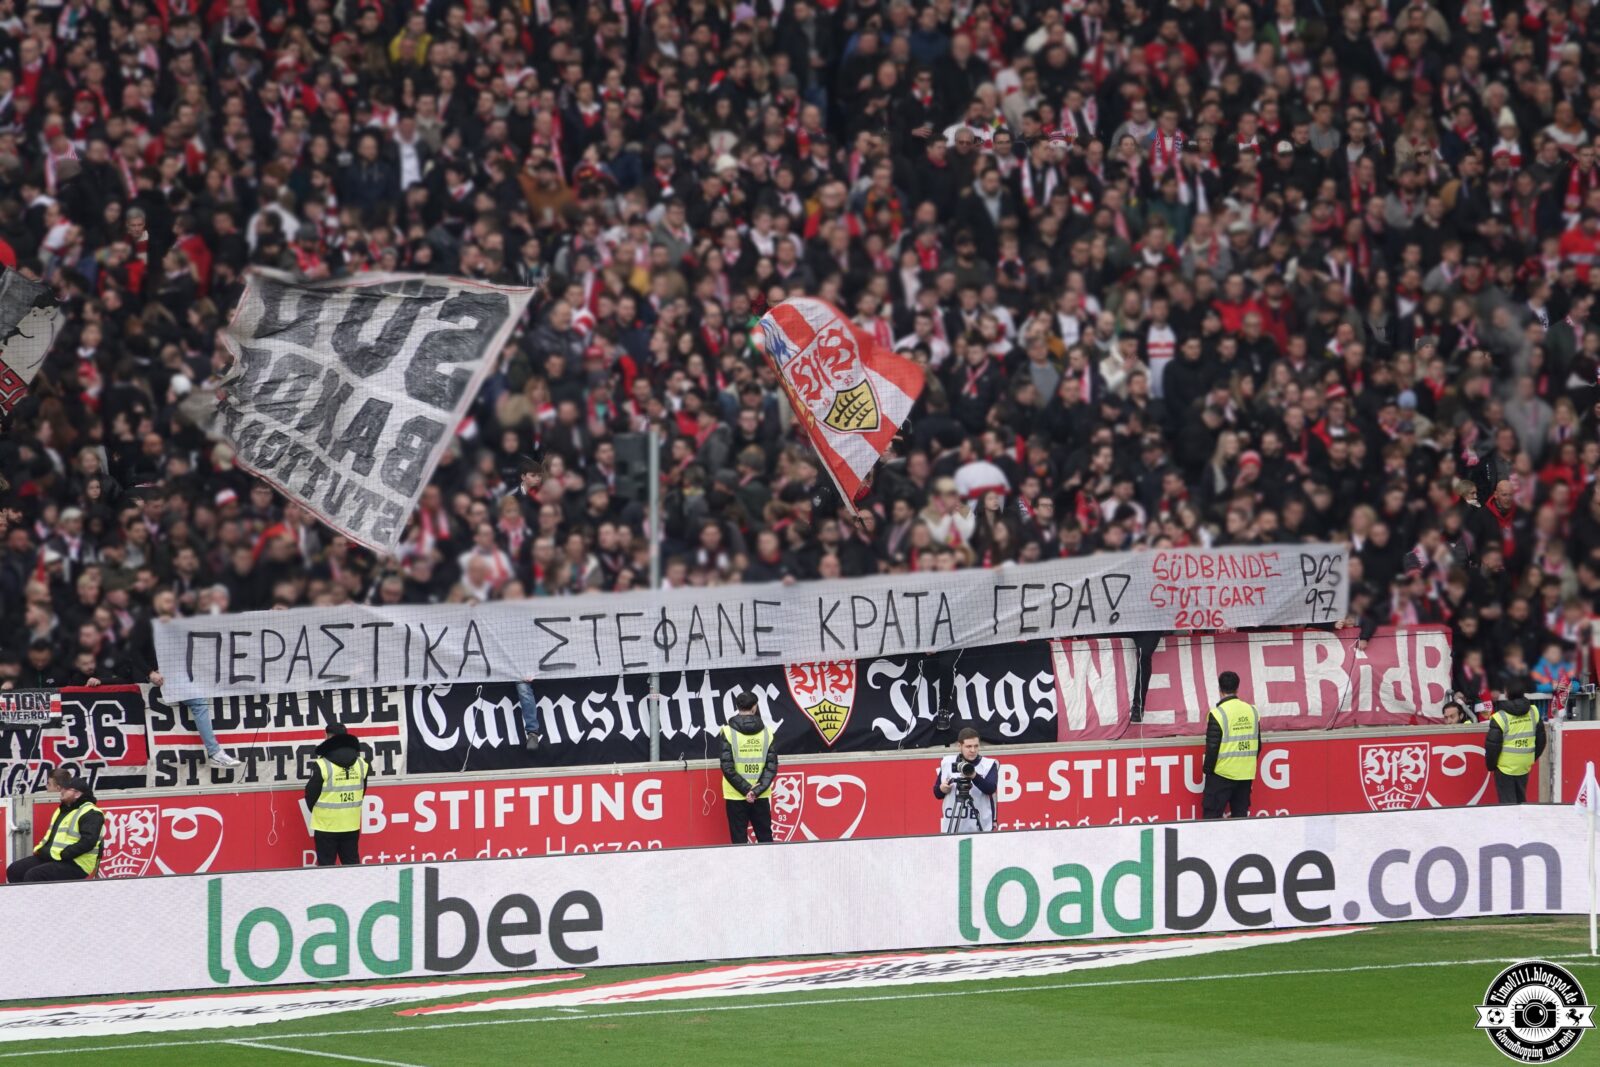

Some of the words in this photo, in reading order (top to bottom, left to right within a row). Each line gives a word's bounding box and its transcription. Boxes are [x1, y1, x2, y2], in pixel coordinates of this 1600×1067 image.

[1151, 552, 1282, 582] SÜDBANDE
[1299, 553, 1342, 587] PCS
[1150, 583, 1267, 609] STUTTGART
[1304, 588, 1338, 622] 97
[1174, 609, 1225, 629] 2016
[185, 621, 492, 684] ΠΕΡΑΣΤΙΚΑ
[533, 599, 782, 671] ΣΤΕΦΑΝΕ
[818, 589, 956, 654] ΚΡΑΤΑ
[866, 658, 1058, 742] Jungs
[54, 699, 127, 761] 36
[154, 740, 402, 787] STUTTGRT
[996, 748, 1290, 803] B-STIFTUG
[1363, 746, 1427, 786] VfB
[339, 791, 355, 803] 1243
[1376, 784, 1385, 792] 18
[1404, 783, 1413, 791] 93
[298, 778, 663, 837] VB-STIFTUNG
[778, 814, 787, 822] 93
[132, 847, 141, 855] 93
[957, 827, 1563, 942] loadbee.com
[207, 867, 604, 985] loadbee
